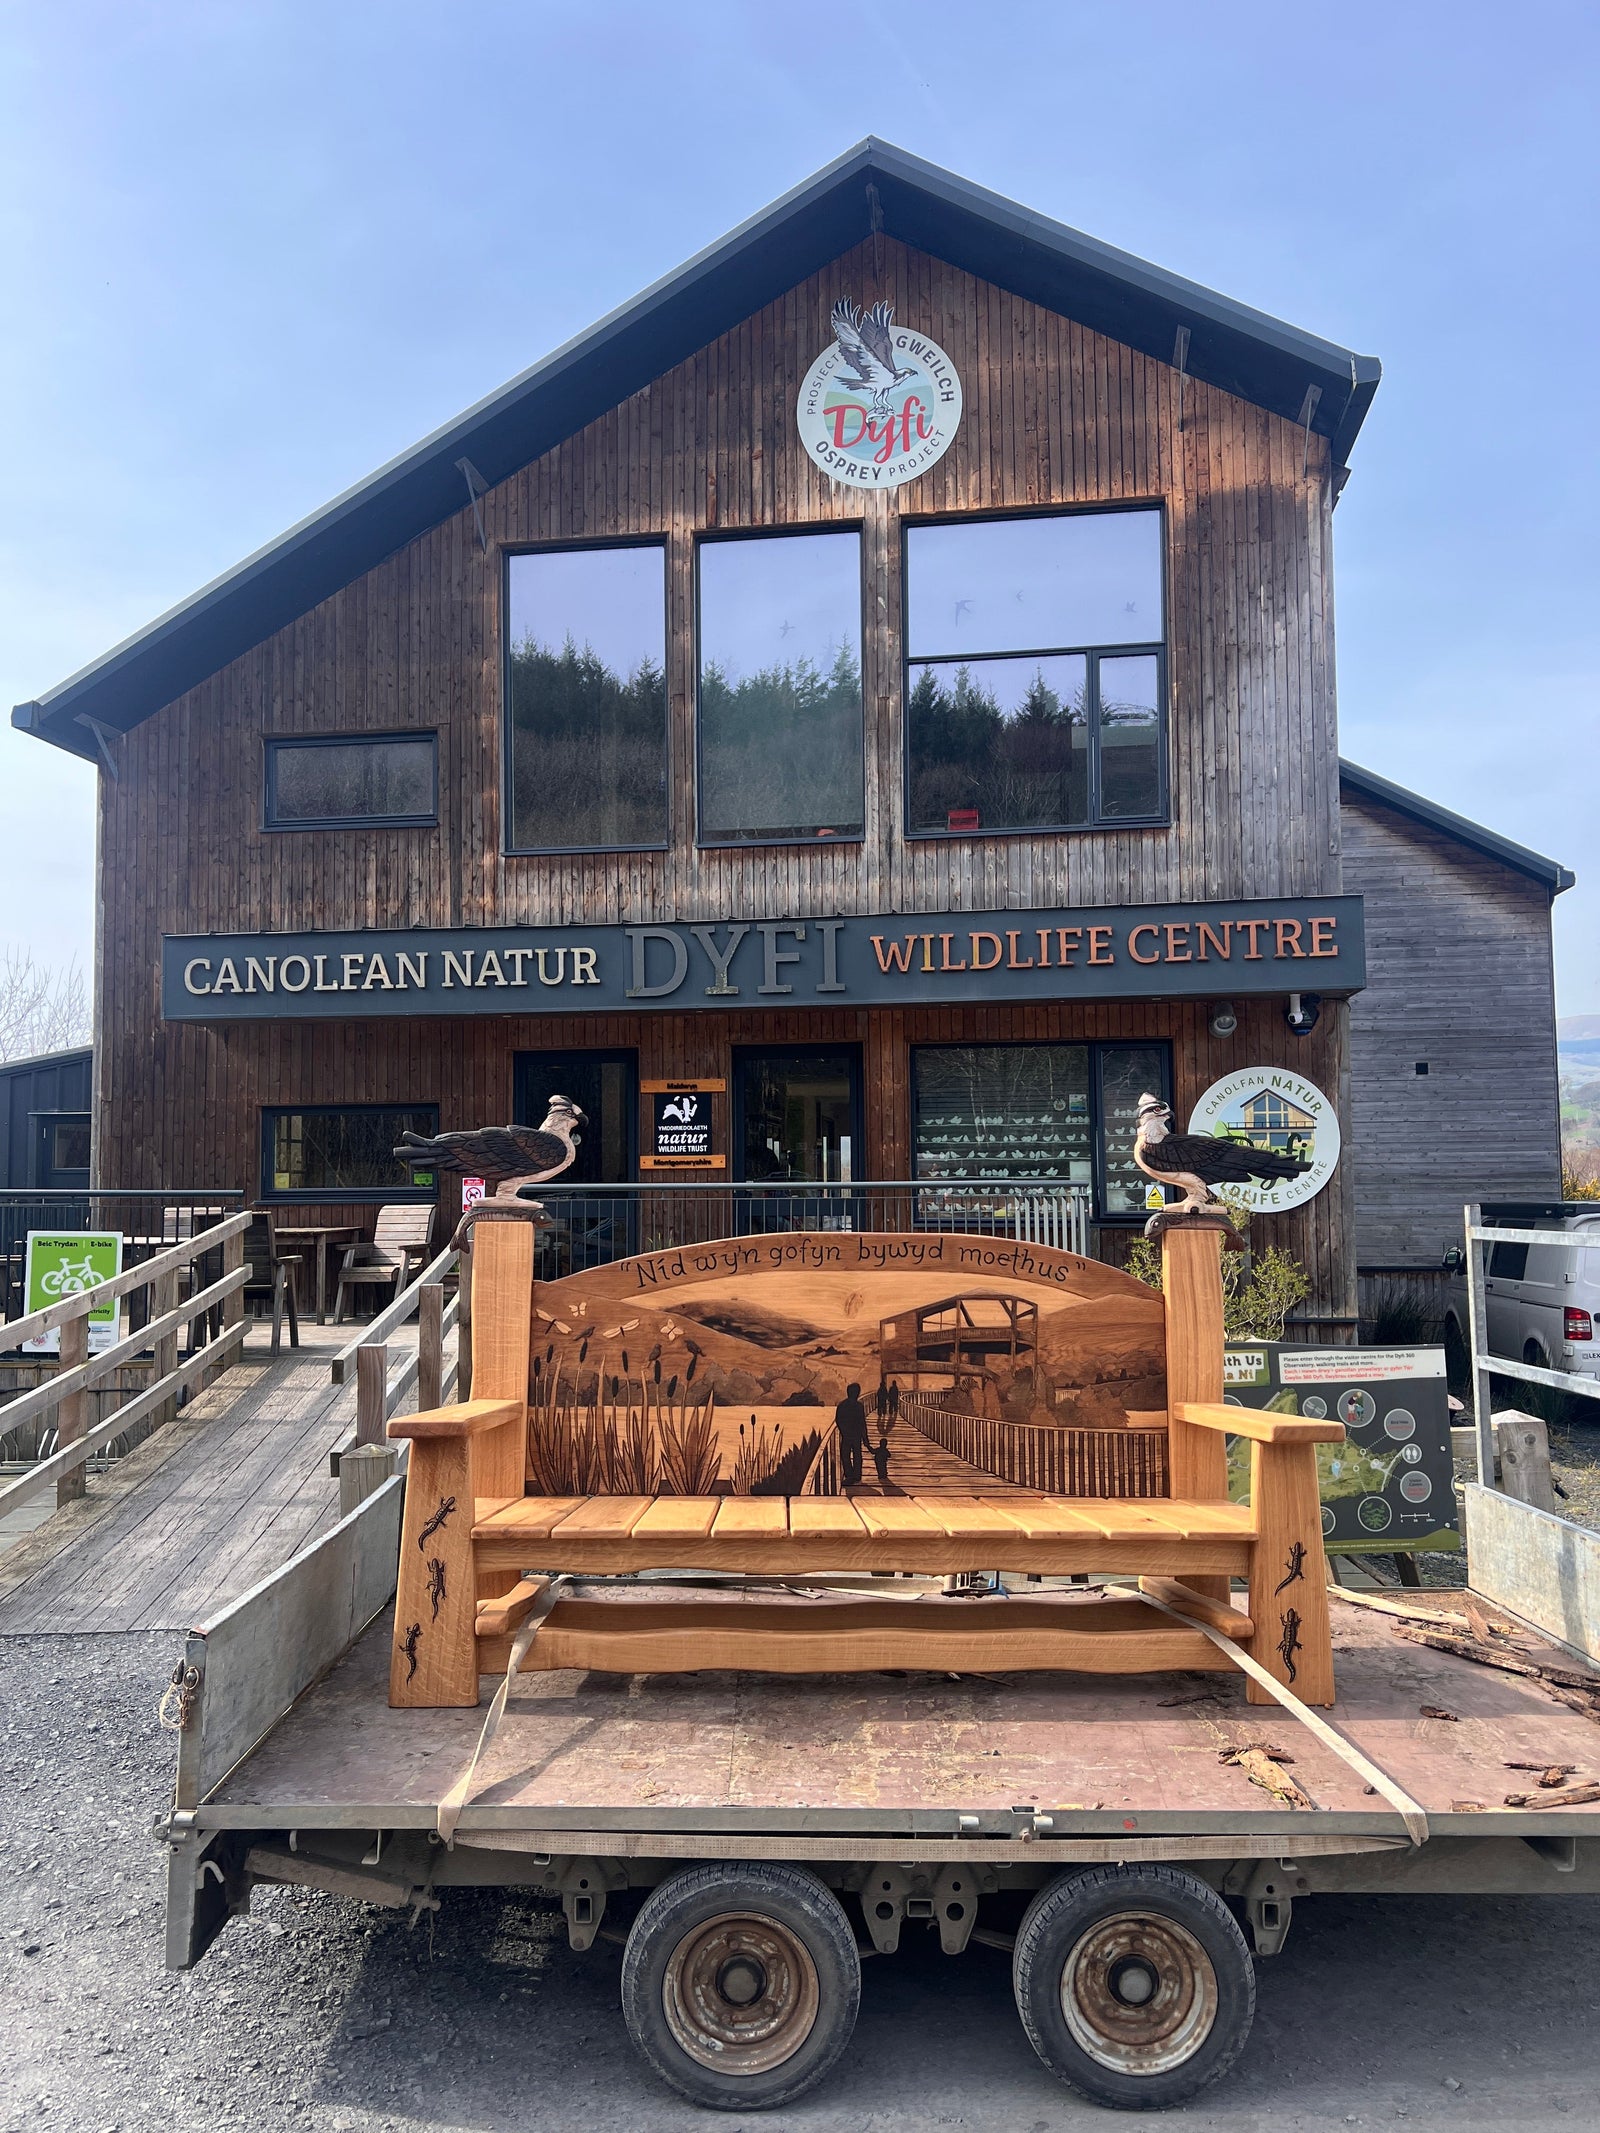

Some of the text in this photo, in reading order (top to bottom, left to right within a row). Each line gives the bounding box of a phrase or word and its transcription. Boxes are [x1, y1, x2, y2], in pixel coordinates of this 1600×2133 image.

[807, 335, 954, 415] PROSIECT GWEILCH
[823, 396, 933, 464] Dyfi
[816, 429, 944, 480] OSPREY PROJECT
[184, 917, 1339, 998] CANOLFAN NATUR DYFI WILDLIFE CENTRE
[1205, 1075, 1322, 1115] CANOLFAN NATUR
[658, 1131, 707, 1144] natur
[1286, 1160, 1328, 1200] CENTRE
[769, 1238, 841, 1267] gofyn
[858, 1237, 943, 1267] bywyd
[1224, 1355, 1262, 1366] ith Us
